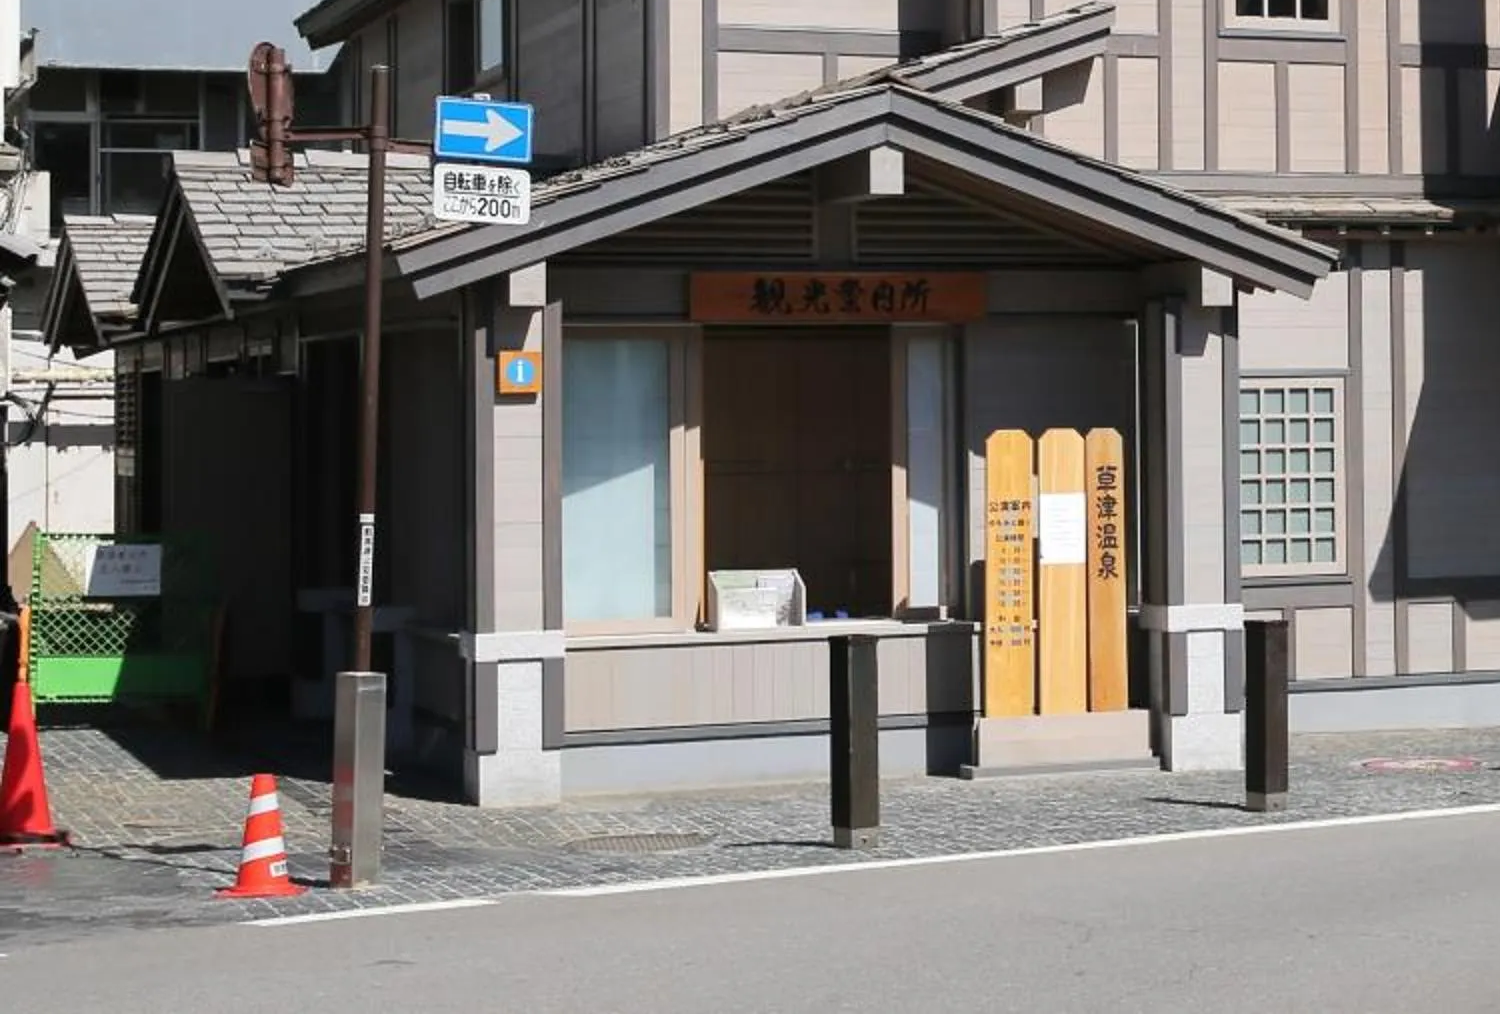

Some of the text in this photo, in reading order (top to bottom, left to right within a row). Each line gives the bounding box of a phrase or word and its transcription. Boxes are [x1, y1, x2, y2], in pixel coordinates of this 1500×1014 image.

[443, 170, 521, 194] 自転車を除く
[749, 276, 930, 315] 観光案内所
[1096, 465, 1119, 580] 草津温泉
